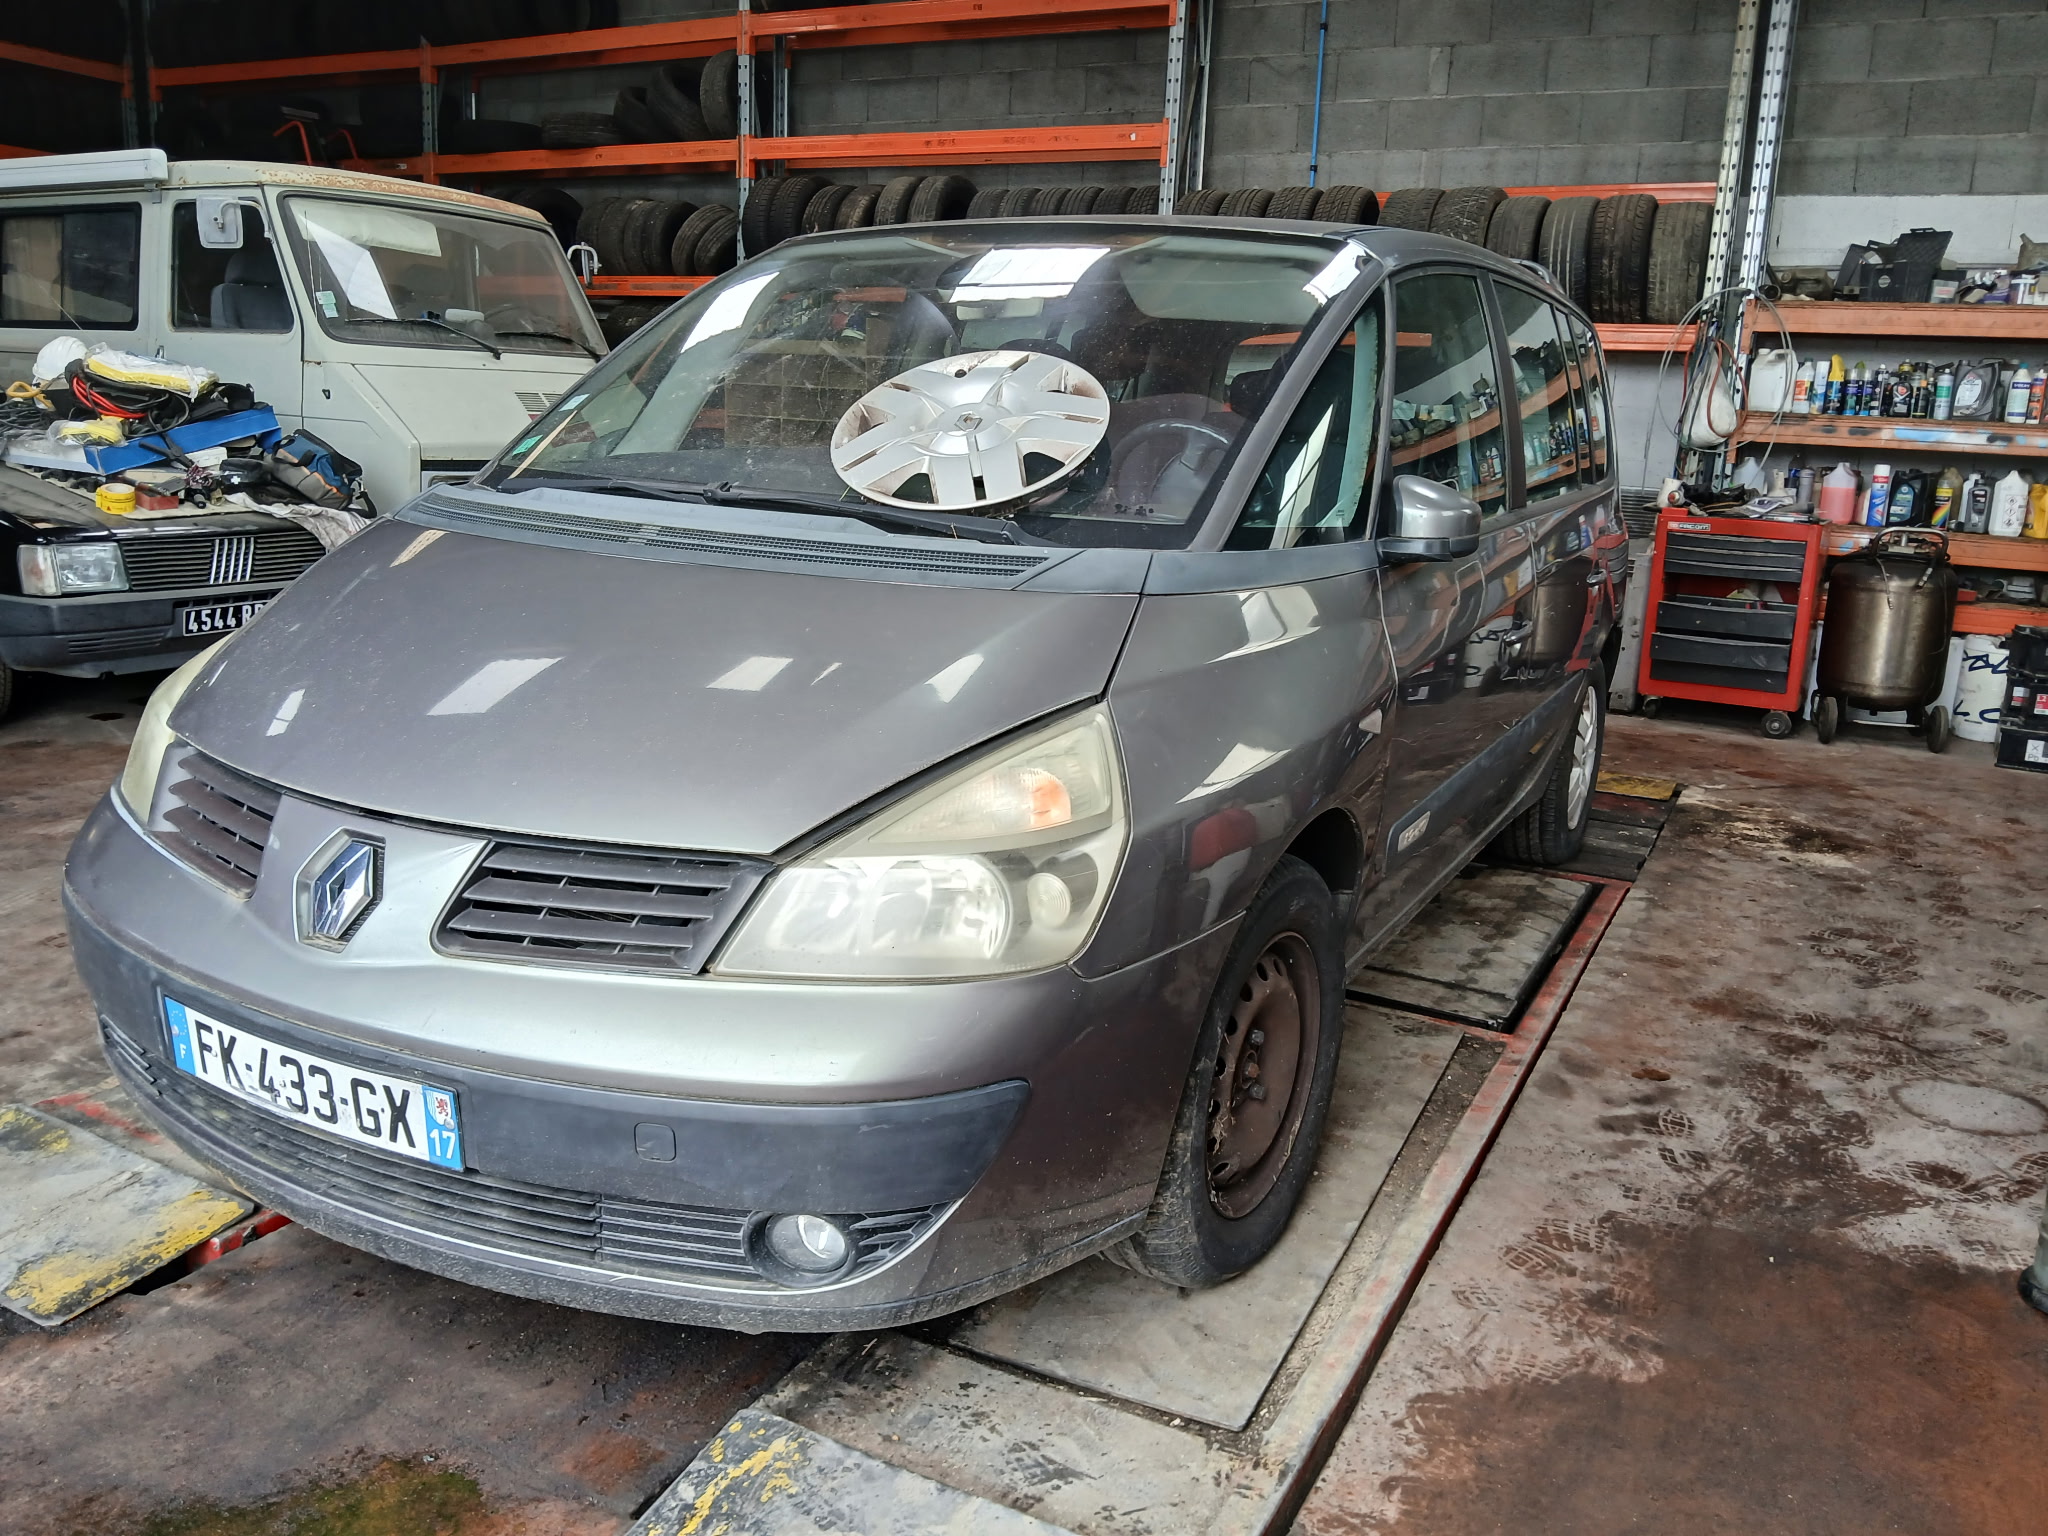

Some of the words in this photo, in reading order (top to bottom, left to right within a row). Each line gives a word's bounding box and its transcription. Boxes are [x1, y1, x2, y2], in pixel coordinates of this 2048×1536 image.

[188, 606, 236, 632] 4544
[179, 1043, 187, 1059] F
[194, 1018, 416, 1149] FK-433-GX
[429, 1128, 456, 1160] 17
